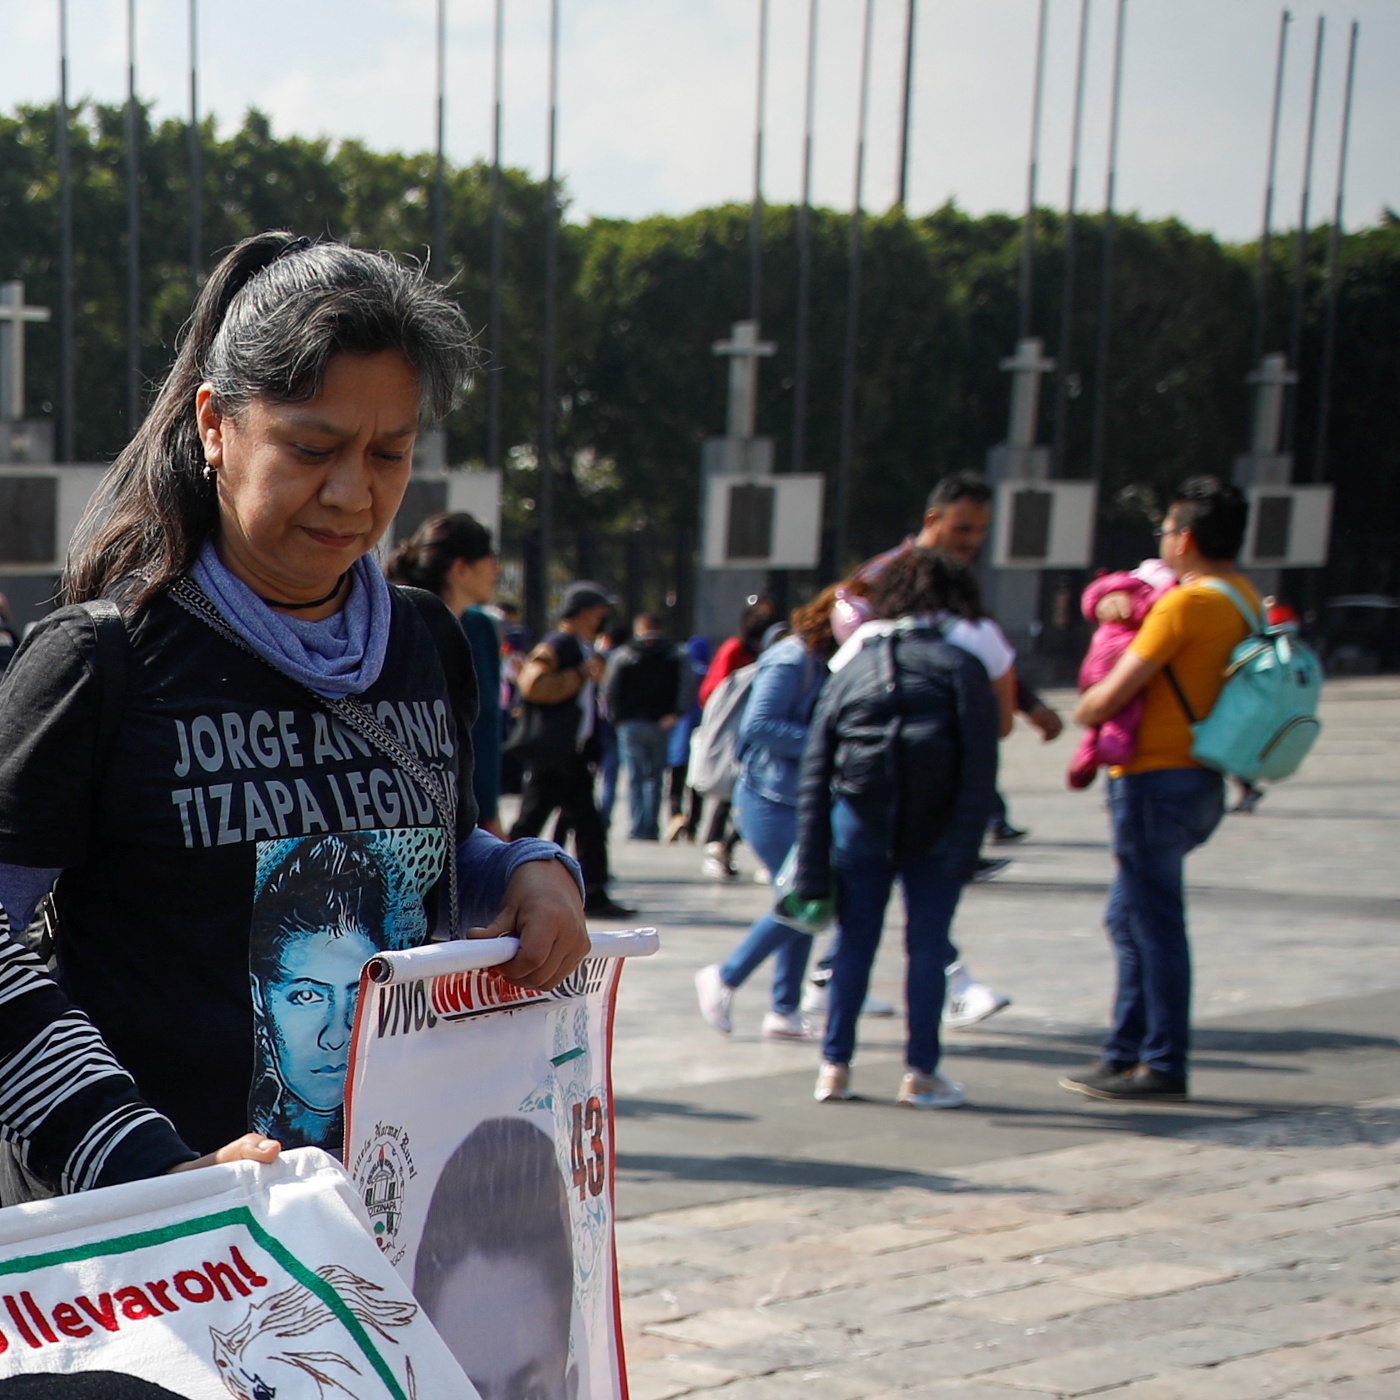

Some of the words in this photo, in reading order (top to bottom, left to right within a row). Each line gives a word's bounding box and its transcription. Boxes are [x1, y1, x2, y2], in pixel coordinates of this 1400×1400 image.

[173, 709, 302, 777] JORGE
[171, 778, 328, 849] TIZAPA
[570, 1097, 605, 1204] 43
[2, 1245, 268, 1350] llevaron!
